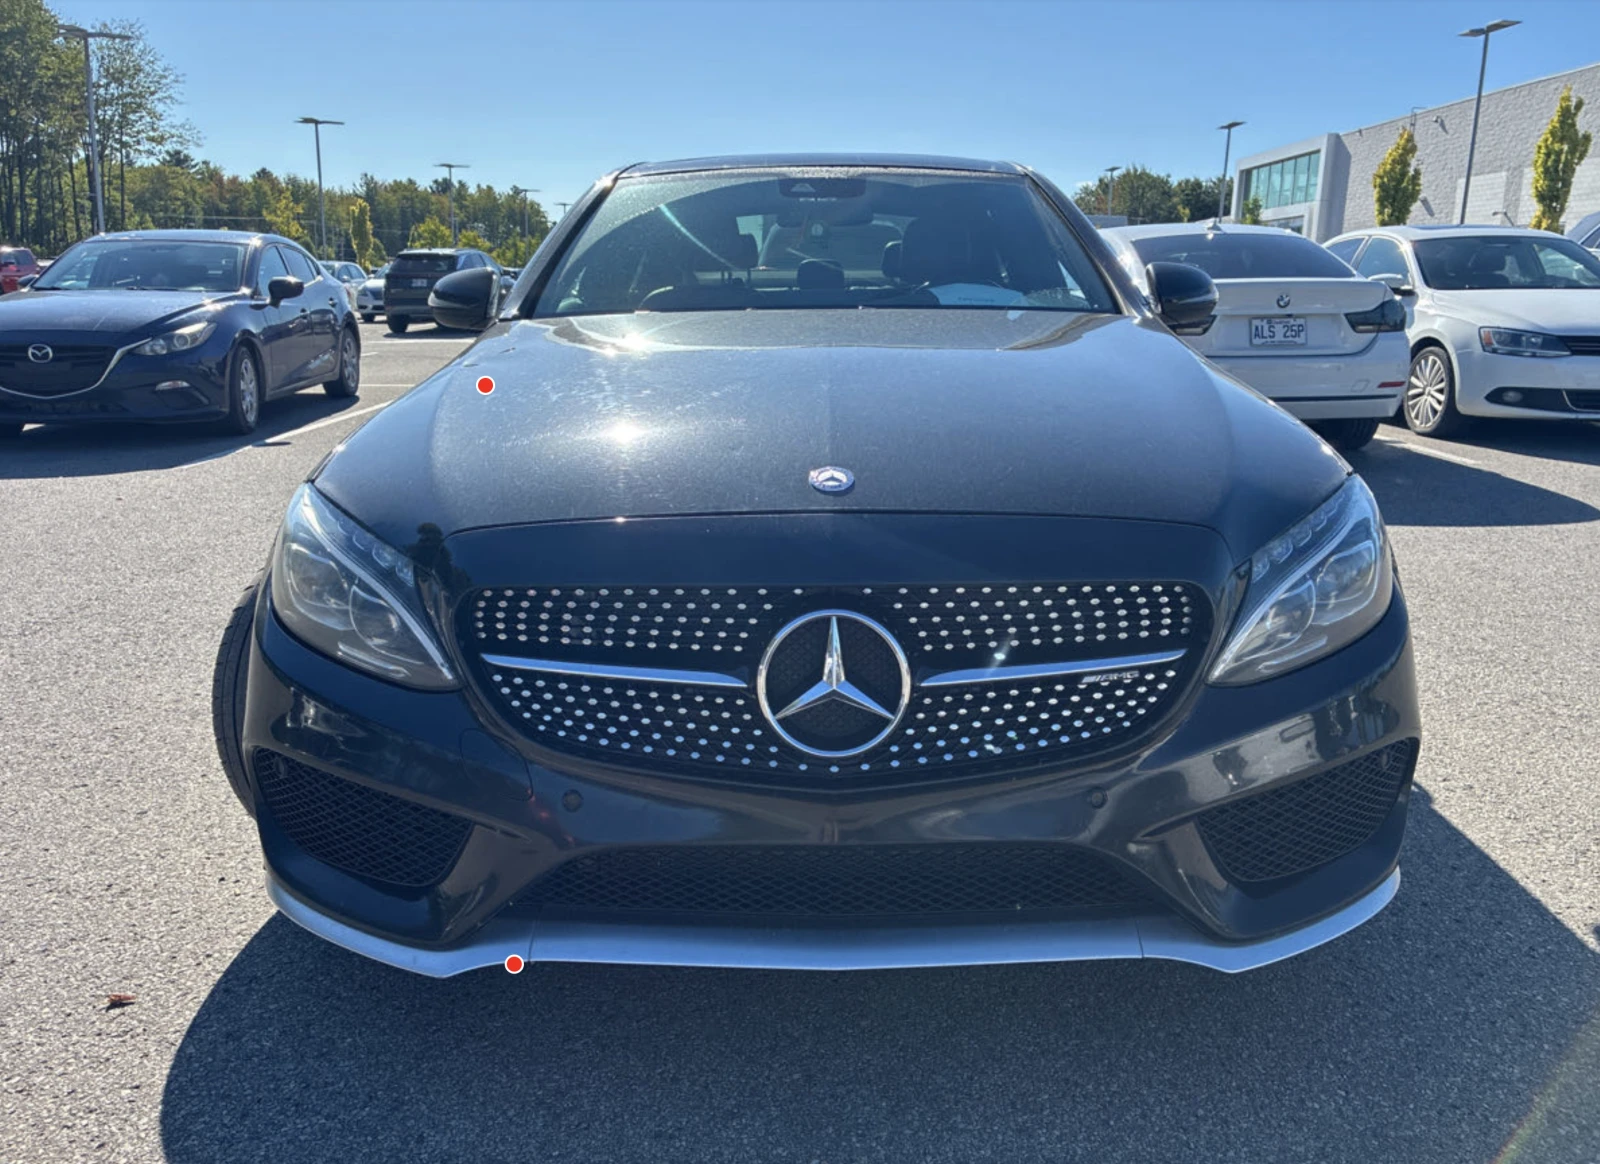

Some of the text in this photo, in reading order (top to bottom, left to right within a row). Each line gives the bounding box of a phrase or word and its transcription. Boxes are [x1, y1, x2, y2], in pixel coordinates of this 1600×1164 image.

[1254, 324, 1304, 339] ALS 25P
[1098, 670, 1139, 681] AMG
